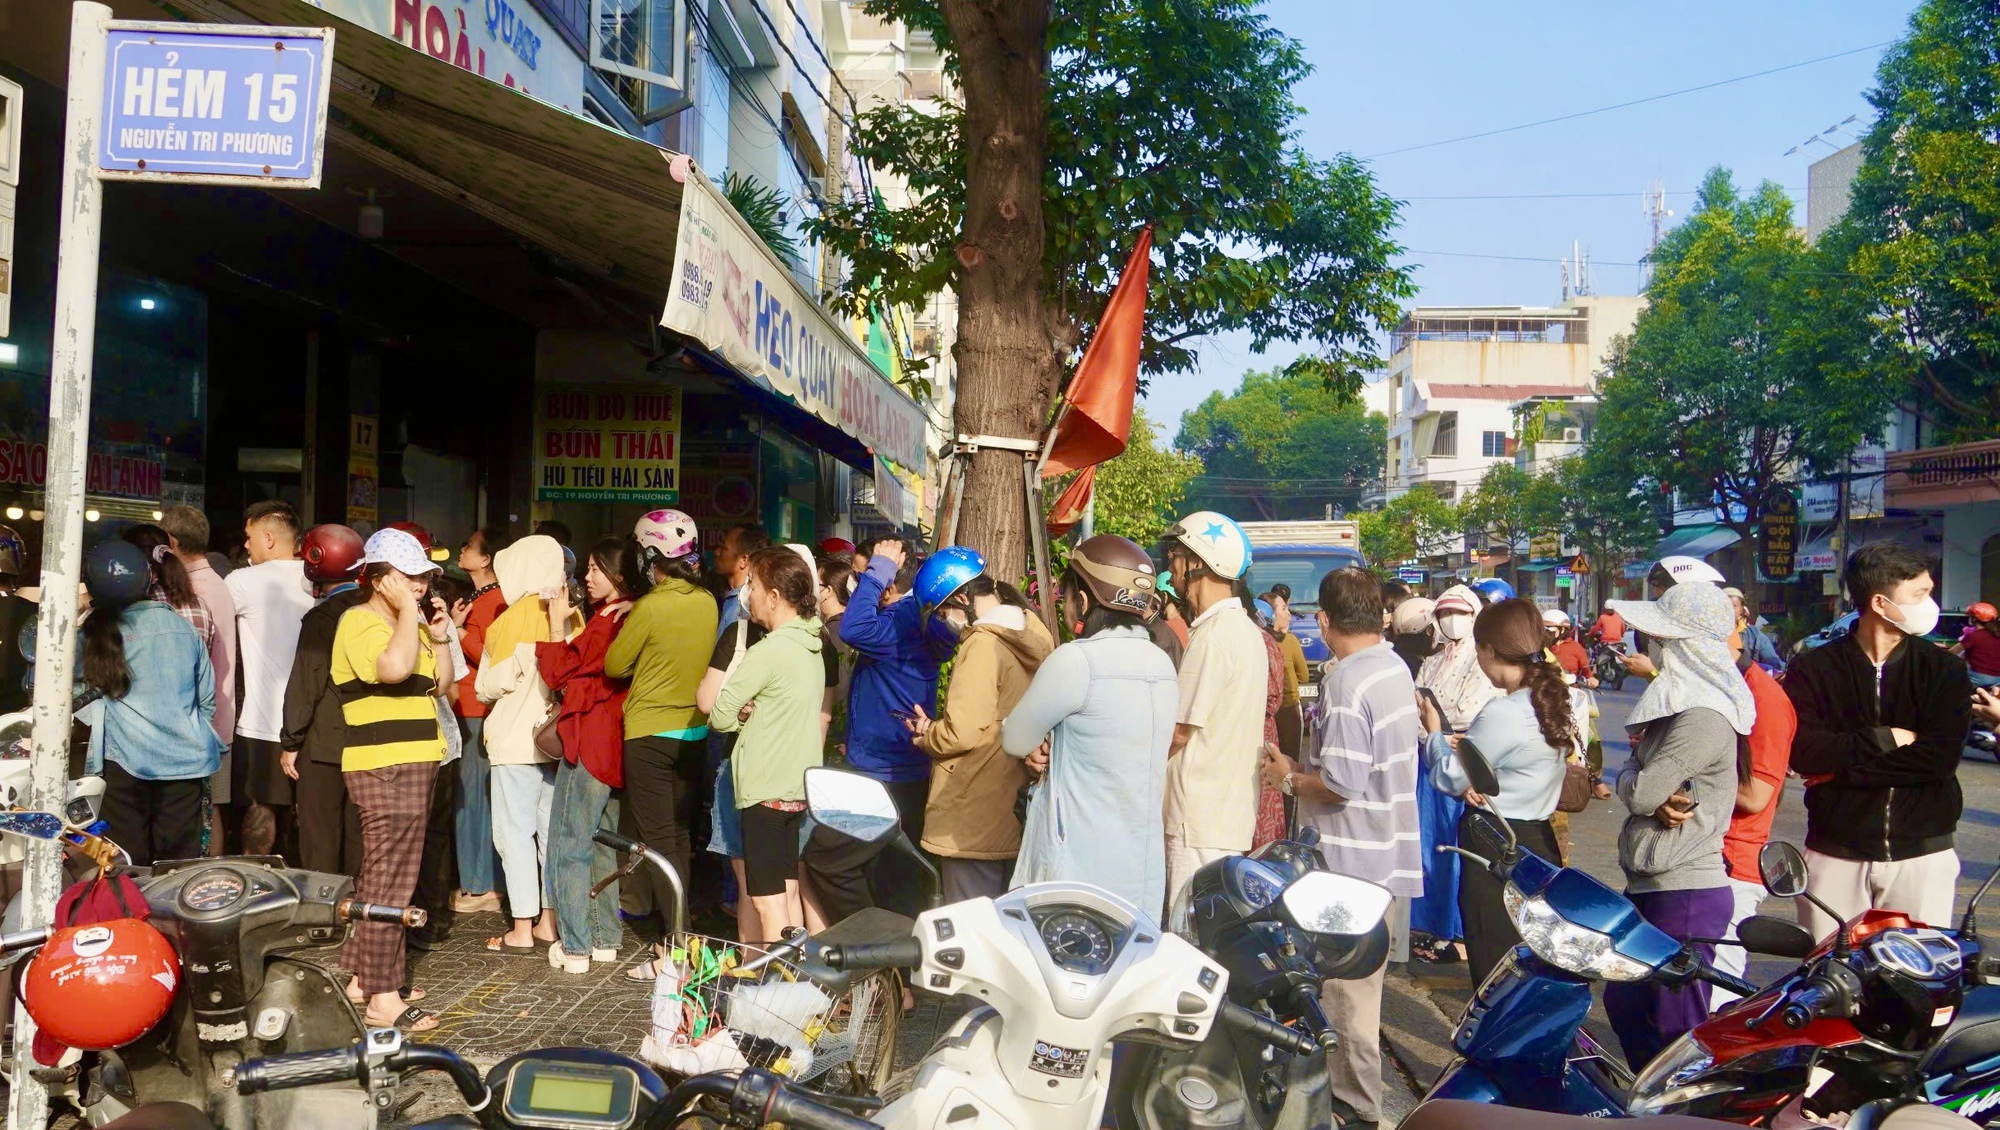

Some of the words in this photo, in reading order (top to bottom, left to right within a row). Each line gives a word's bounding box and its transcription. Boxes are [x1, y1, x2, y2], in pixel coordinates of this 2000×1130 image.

[123, 51, 226, 119] HẺM
[244, 72, 298, 123] 15
[120, 123, 187, 150] NGUYỄN
[192, 131, 217, 152] TRI
[222, 132, 293, 156] PHƯƠNG
[755, 279, 794, 379] HEO
[798, 325, 837, 410] QUAY
[546, 426, 601, 459] BÚN
[611, 427, 674, 460] THÁI
[572, 462, 605, 488] TIẾU
[611, 464, 638, 488] HẢI
[644, 464, 674, 489] SẢN
[566, 491, 576, 499] 19
[617, 492, 630, 500] TRI
